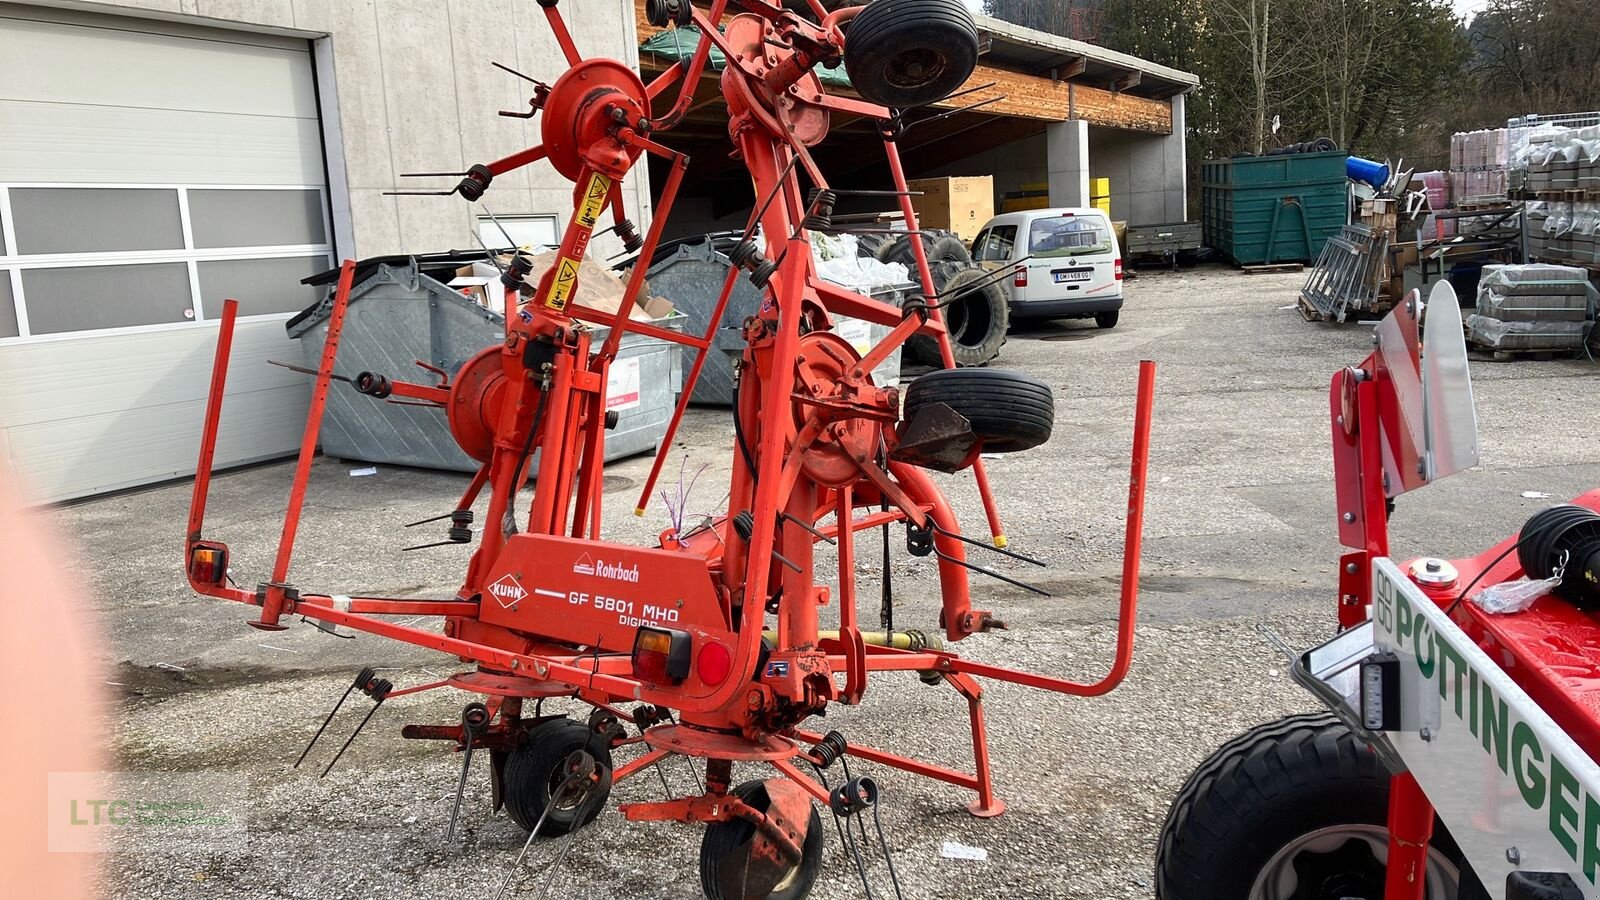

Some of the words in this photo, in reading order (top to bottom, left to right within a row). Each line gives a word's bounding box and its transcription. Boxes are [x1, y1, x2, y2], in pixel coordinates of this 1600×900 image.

[596, 559, 639, 583] Rohrbach
[493, 583, 521, 599] KUHN
[569, 591, 589, 605] GF
[594, 596, 634, 615] 5801
